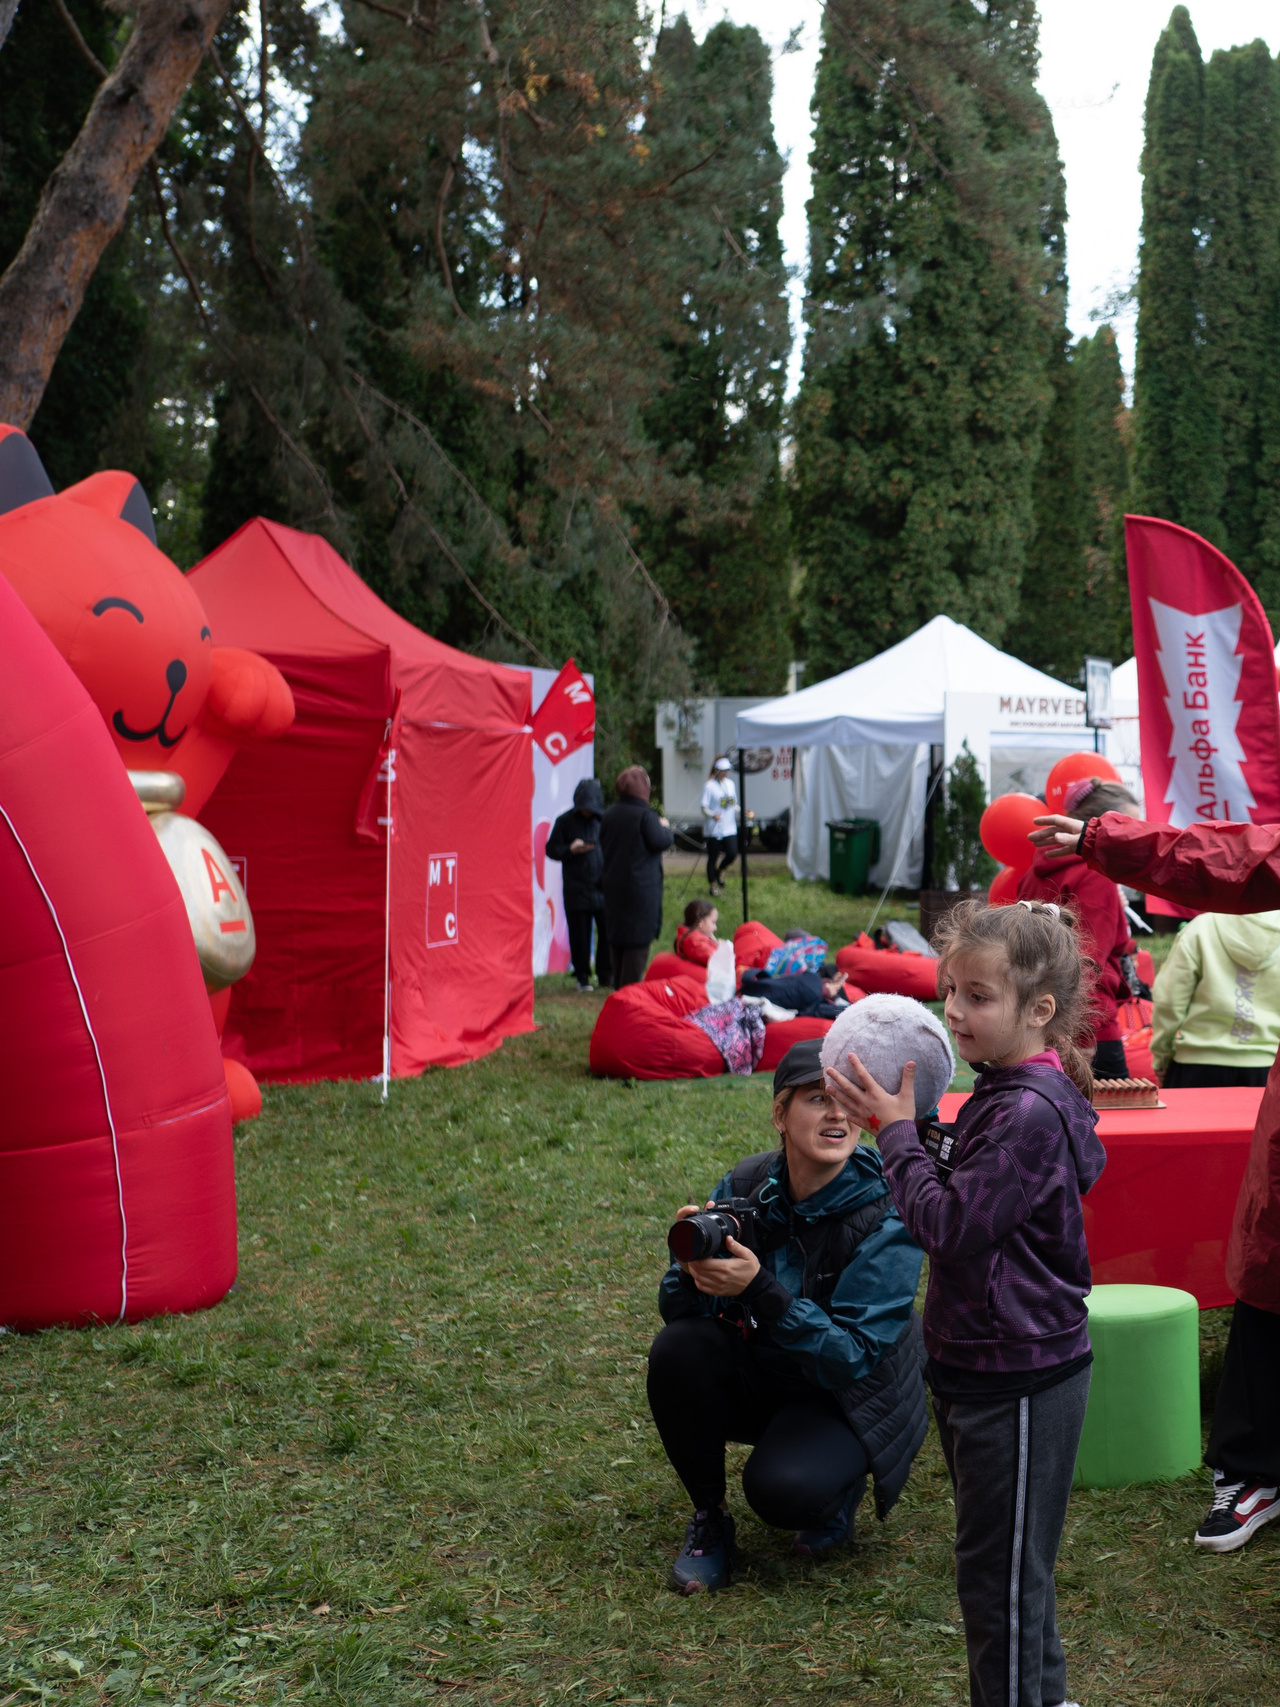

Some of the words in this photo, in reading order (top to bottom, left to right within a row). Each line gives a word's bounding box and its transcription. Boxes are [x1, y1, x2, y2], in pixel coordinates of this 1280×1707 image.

[1000, 696, 1087, 715] MAYRVED
[1182, 631, 1209, 711] Банк
[1188, 719, 1218, 821] Альфа
